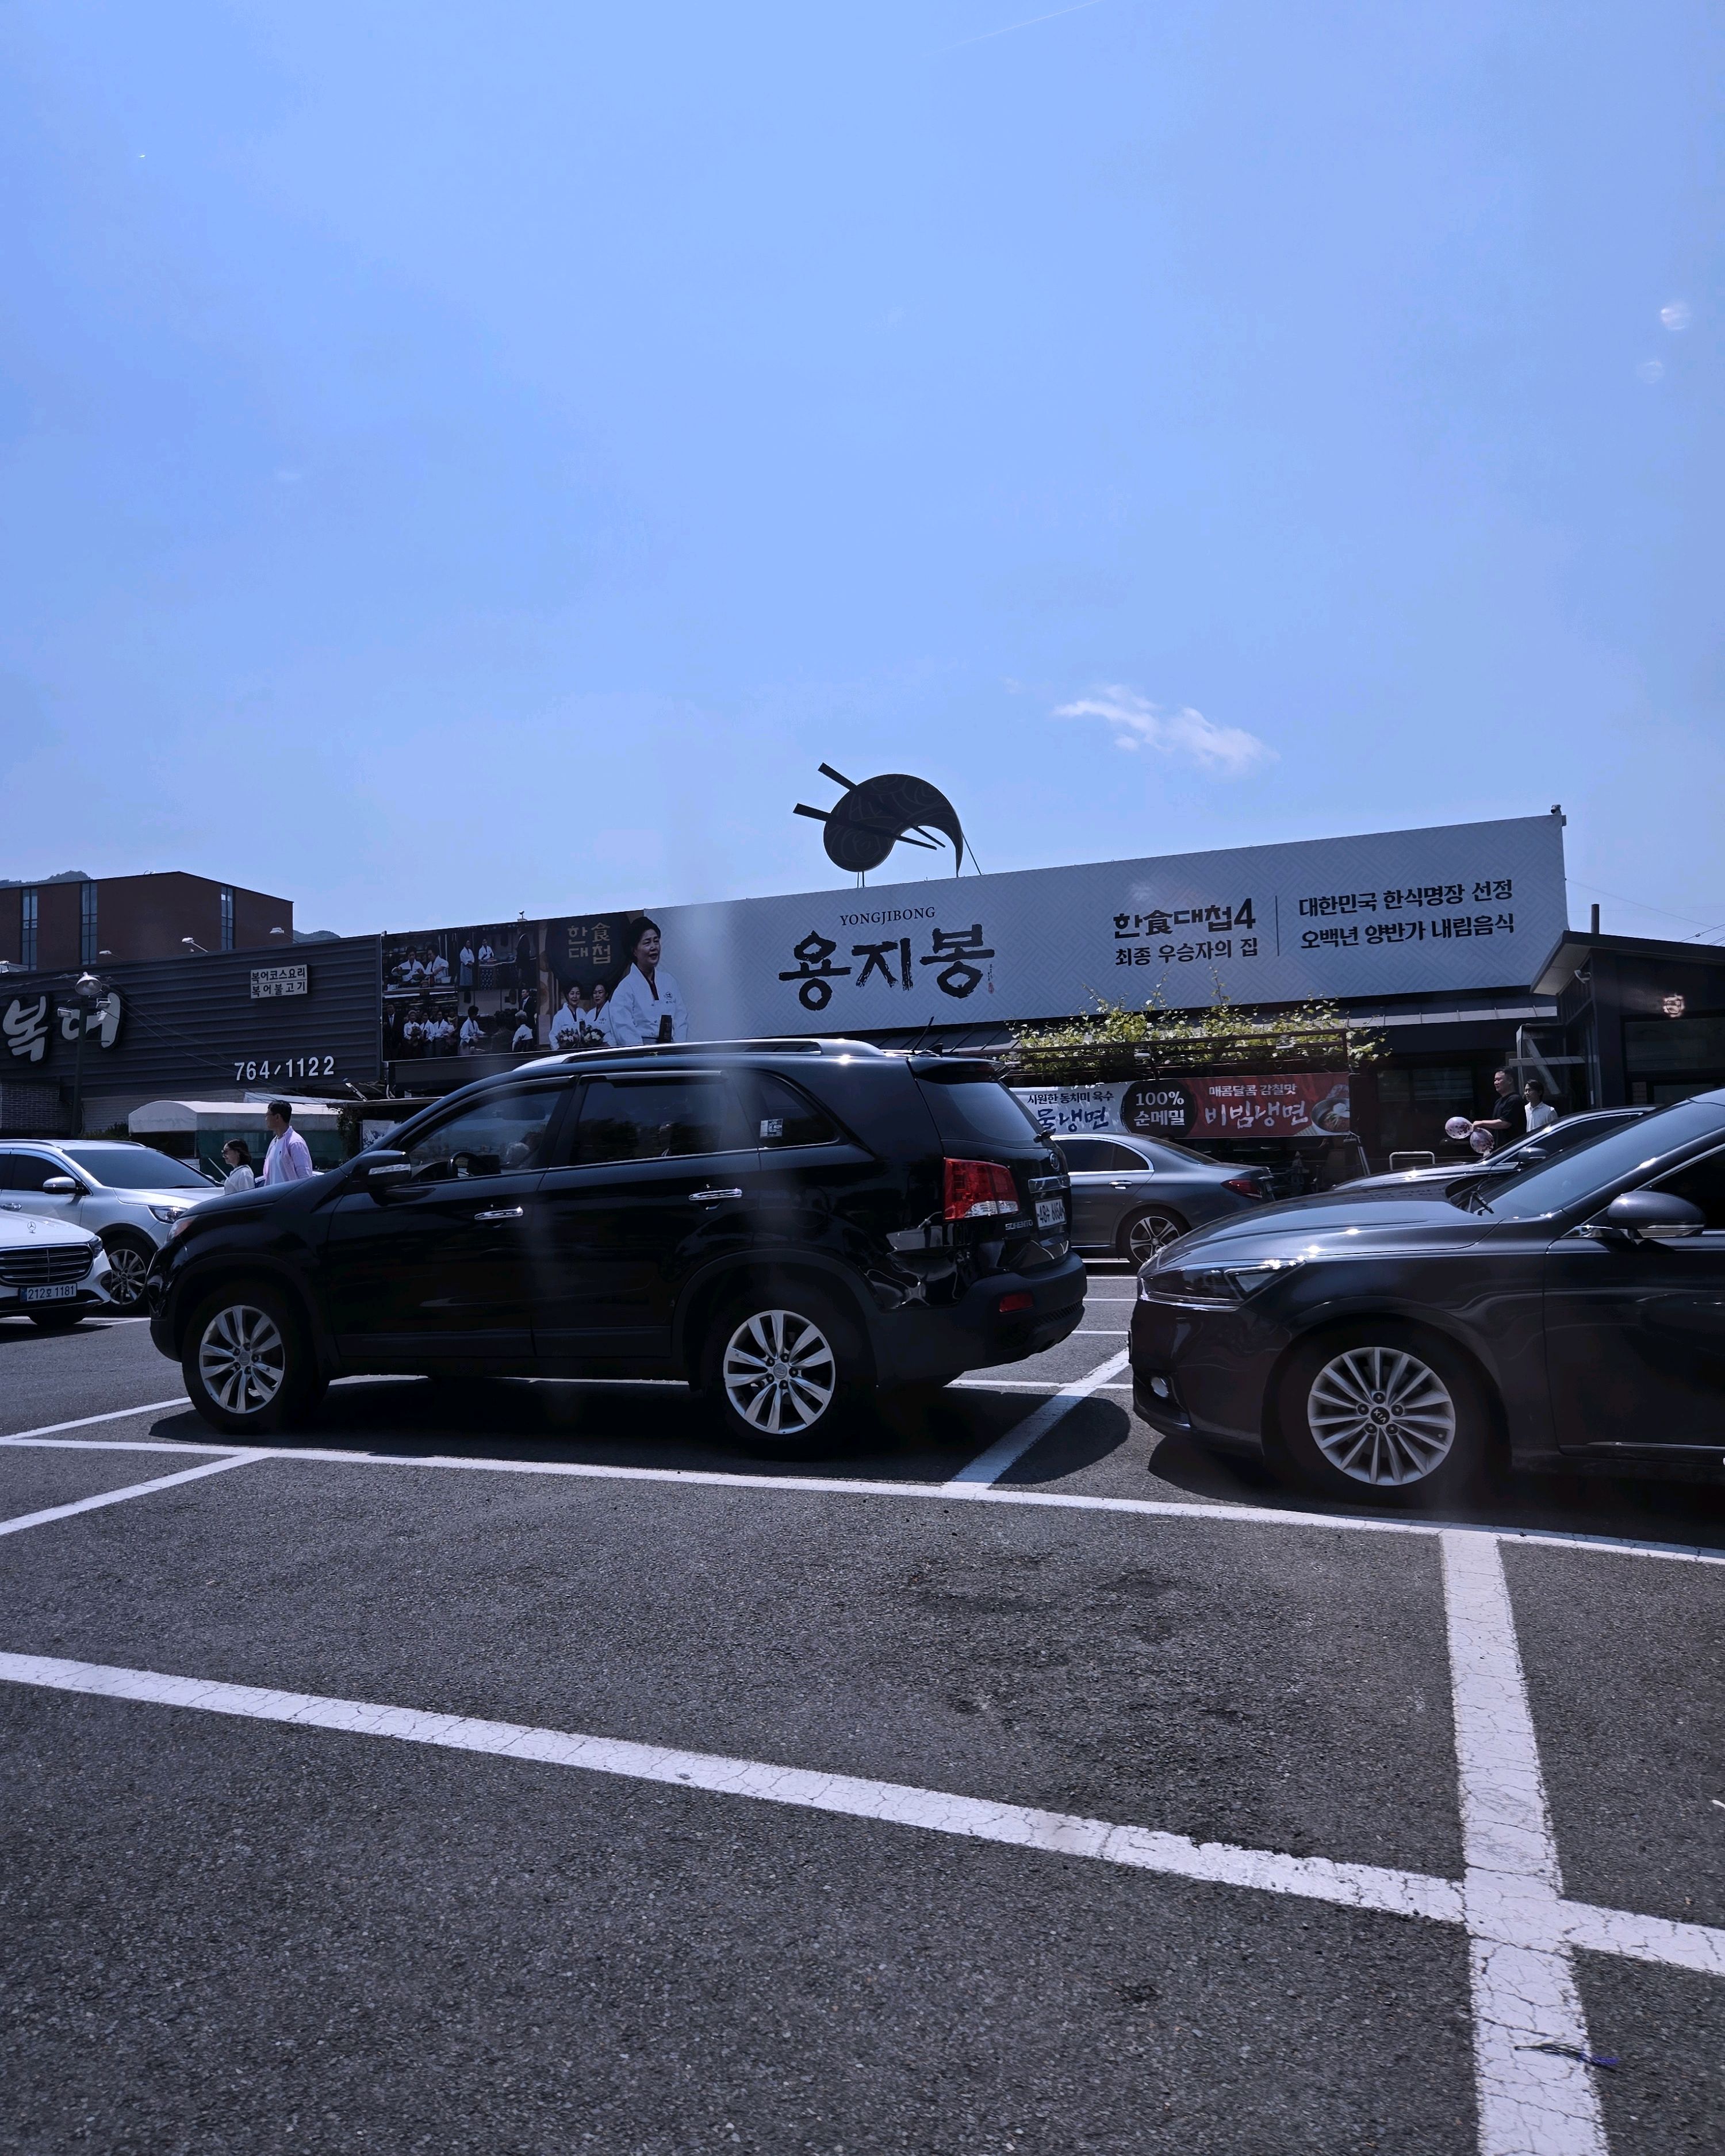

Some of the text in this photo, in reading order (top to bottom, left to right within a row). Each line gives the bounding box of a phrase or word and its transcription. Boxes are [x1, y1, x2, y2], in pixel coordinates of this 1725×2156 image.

[1298, 879, 1513, 918] 대한민국 한식명장 선정
[839, 907, 936, 926] YONGJIBONG
[1300, 912, 1515, 949] 오백년 양반가 내림음식
[568, 943, 611, 965] 대첩
[1115, 938, 1258, 966] 최종 우승자의 집
[251, 967, 305, 984] 복어코스요리
[778, 923, 995, 1011] 용지봉
[252, 981, 305, 998] 복어불고기
[1027, 1091, 1114, 1105] 시원한 동치미 육수
[1135, 1091, 1184, 1106] 100%
[1209, 1083, 1297, 1097] 매콤달콤 감칠맛
[1037, 1106, 1109, 1133] 물냉면
[1133, 1108, 1186, 1126] 순메밀
[1204, 1099, 1309, 1129] 비빔냉면
[28, 1285, 74, 1299] 212호 1181
